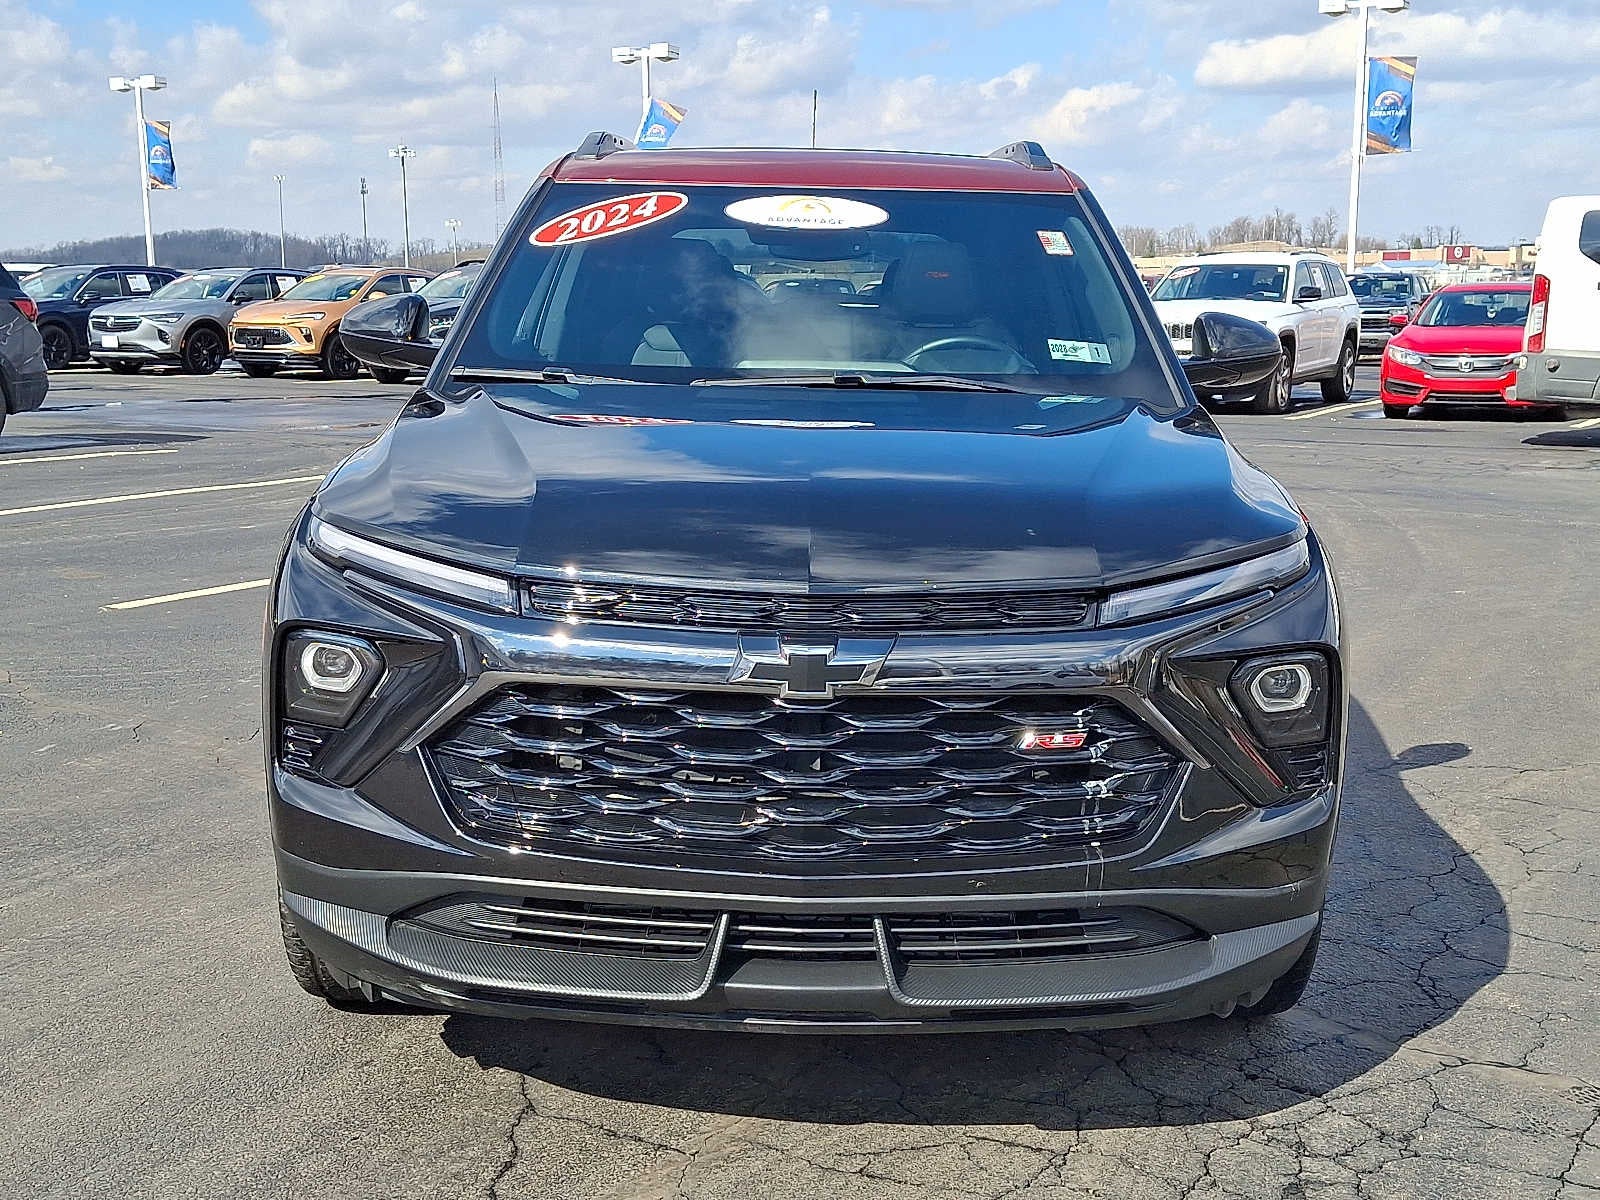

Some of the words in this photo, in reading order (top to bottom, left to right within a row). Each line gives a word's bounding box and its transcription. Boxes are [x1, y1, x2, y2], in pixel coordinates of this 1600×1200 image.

[555, 194, 659, 243] 2024
[767, 216, 846, 226] ADVANTAGE
[1034, 733, 1088, 749] RS
